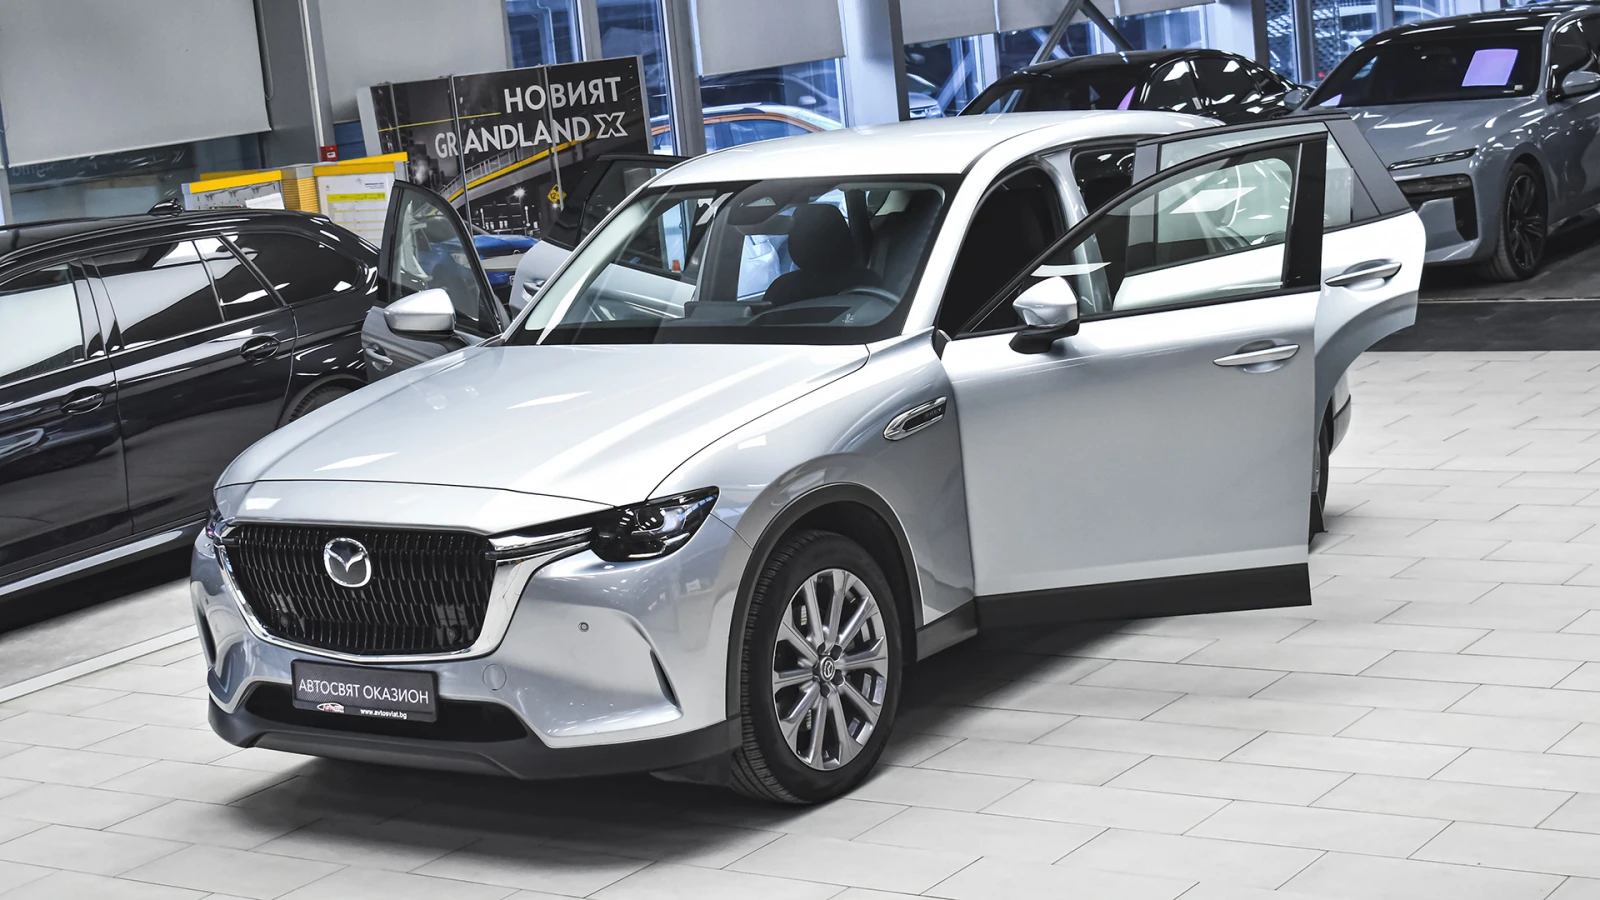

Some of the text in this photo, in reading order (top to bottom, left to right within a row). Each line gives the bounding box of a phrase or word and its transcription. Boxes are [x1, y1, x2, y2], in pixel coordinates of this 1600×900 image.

[504, 76, 621, 113] НОВИЯТ
[434, 111, 629, 159] GRANDLAND X
[299, 678, 429, 704] АВТОСВЯТ ОКАЗИОН
